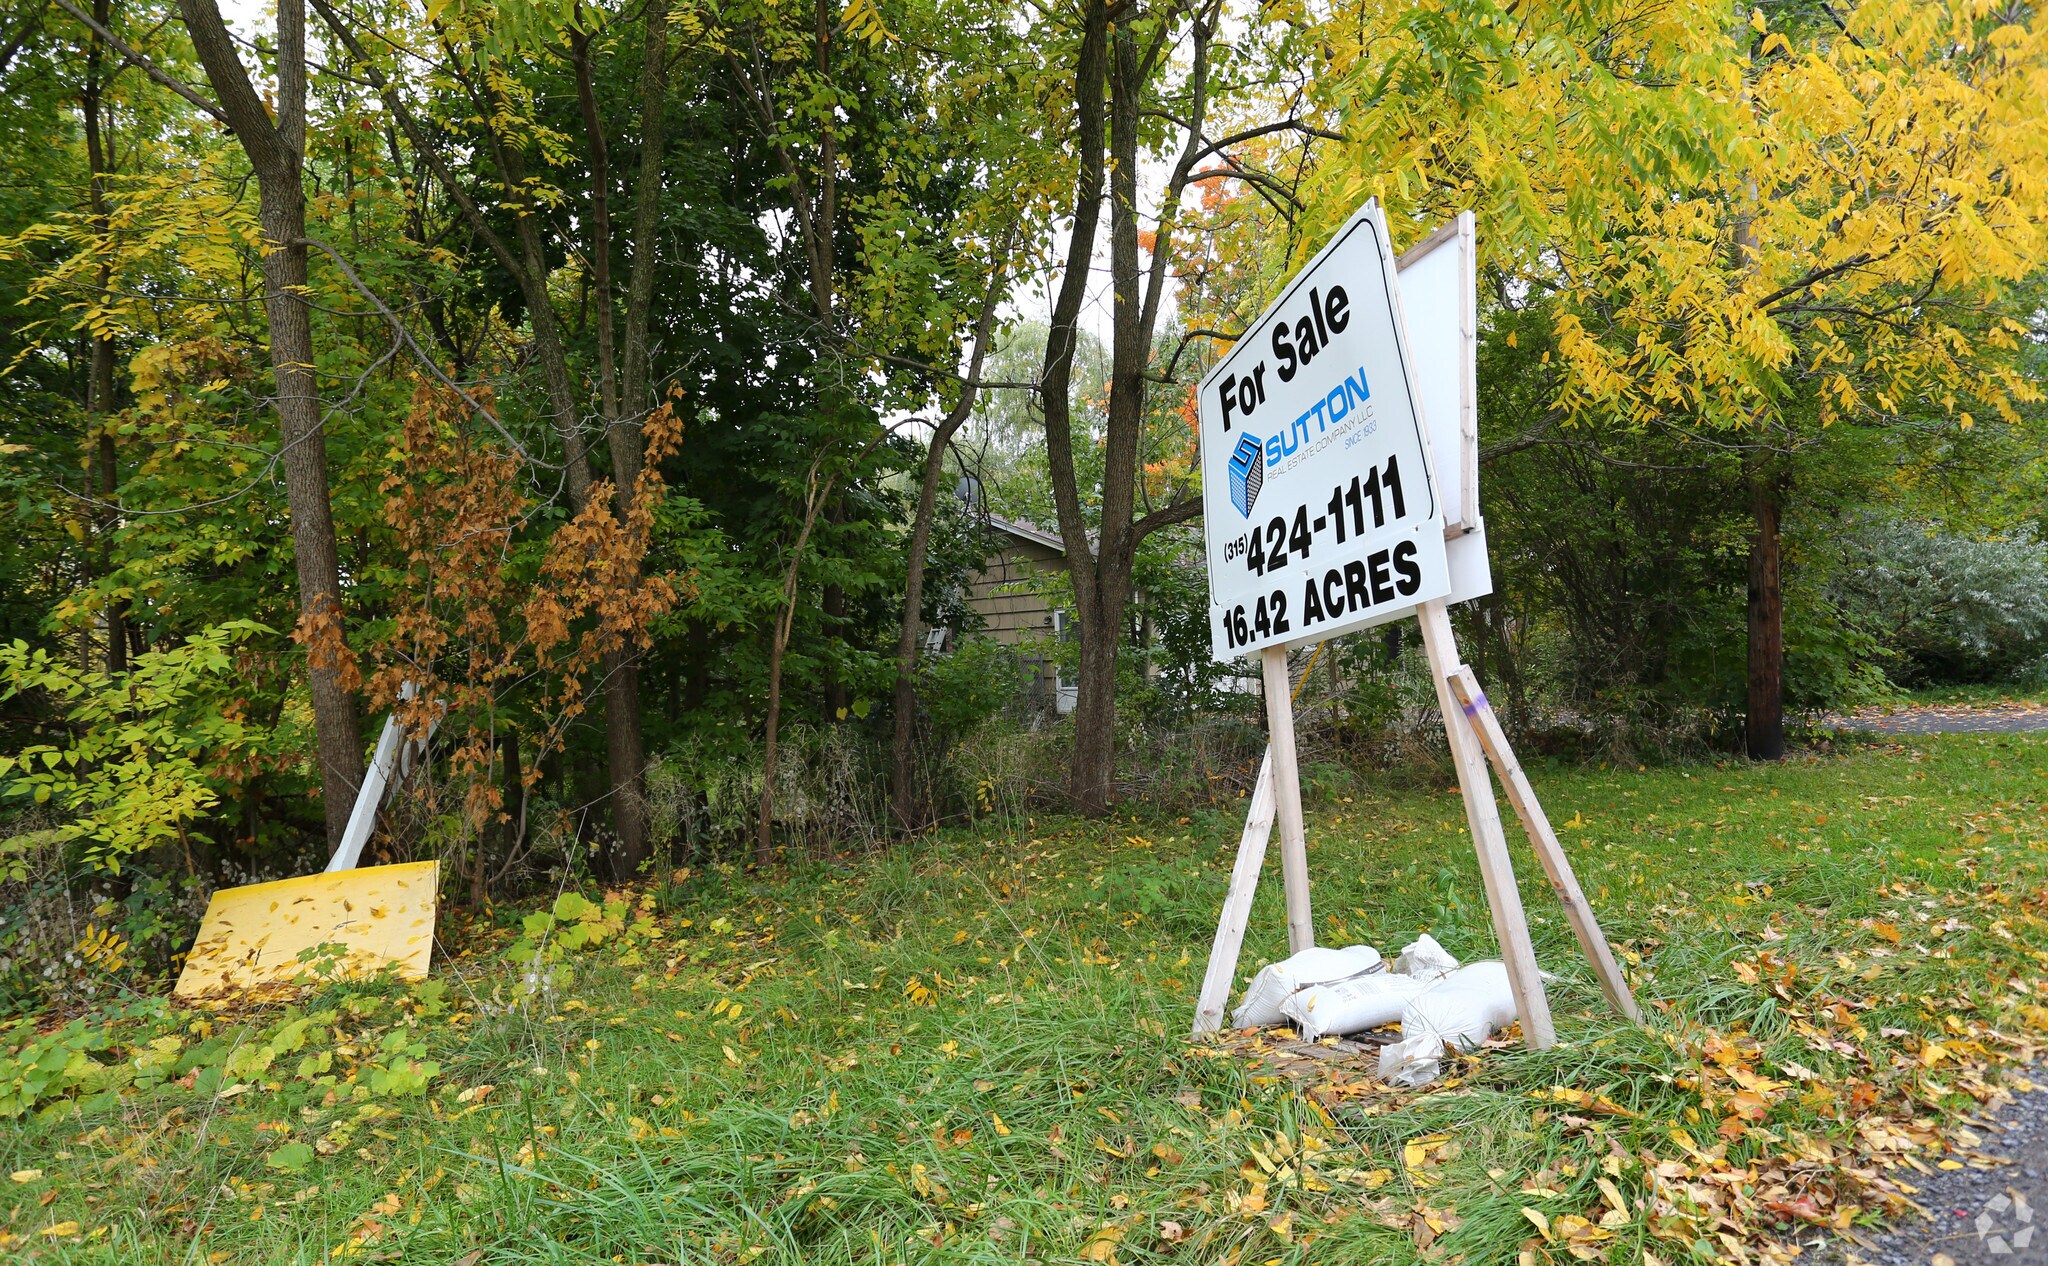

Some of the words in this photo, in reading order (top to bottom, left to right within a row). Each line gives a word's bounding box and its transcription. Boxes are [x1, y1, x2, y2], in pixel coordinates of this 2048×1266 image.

[1219, 360, 1265, 432] For
[1272, 285, 1350, 383] Sale
[1265, 366, 1370, 467] SUTTON
[1267, 465, 1287, 482] REAL
[1287, 445, 1315, 471] ESTATE
[1315, 416, 1356, 453] COMPANY
[1357, 405, 1374, 424] LLC
[1344, 430, 1362, 450] SINCE
[1363, 420, 1377, 438] 1933
[1224, 533, 1248, 563] (315)
[1246, 454, 1406, 577] 424-1111
[1223, 589, 1290, 649] 16.42
[1303, 540, 1421, 626] ACRES
